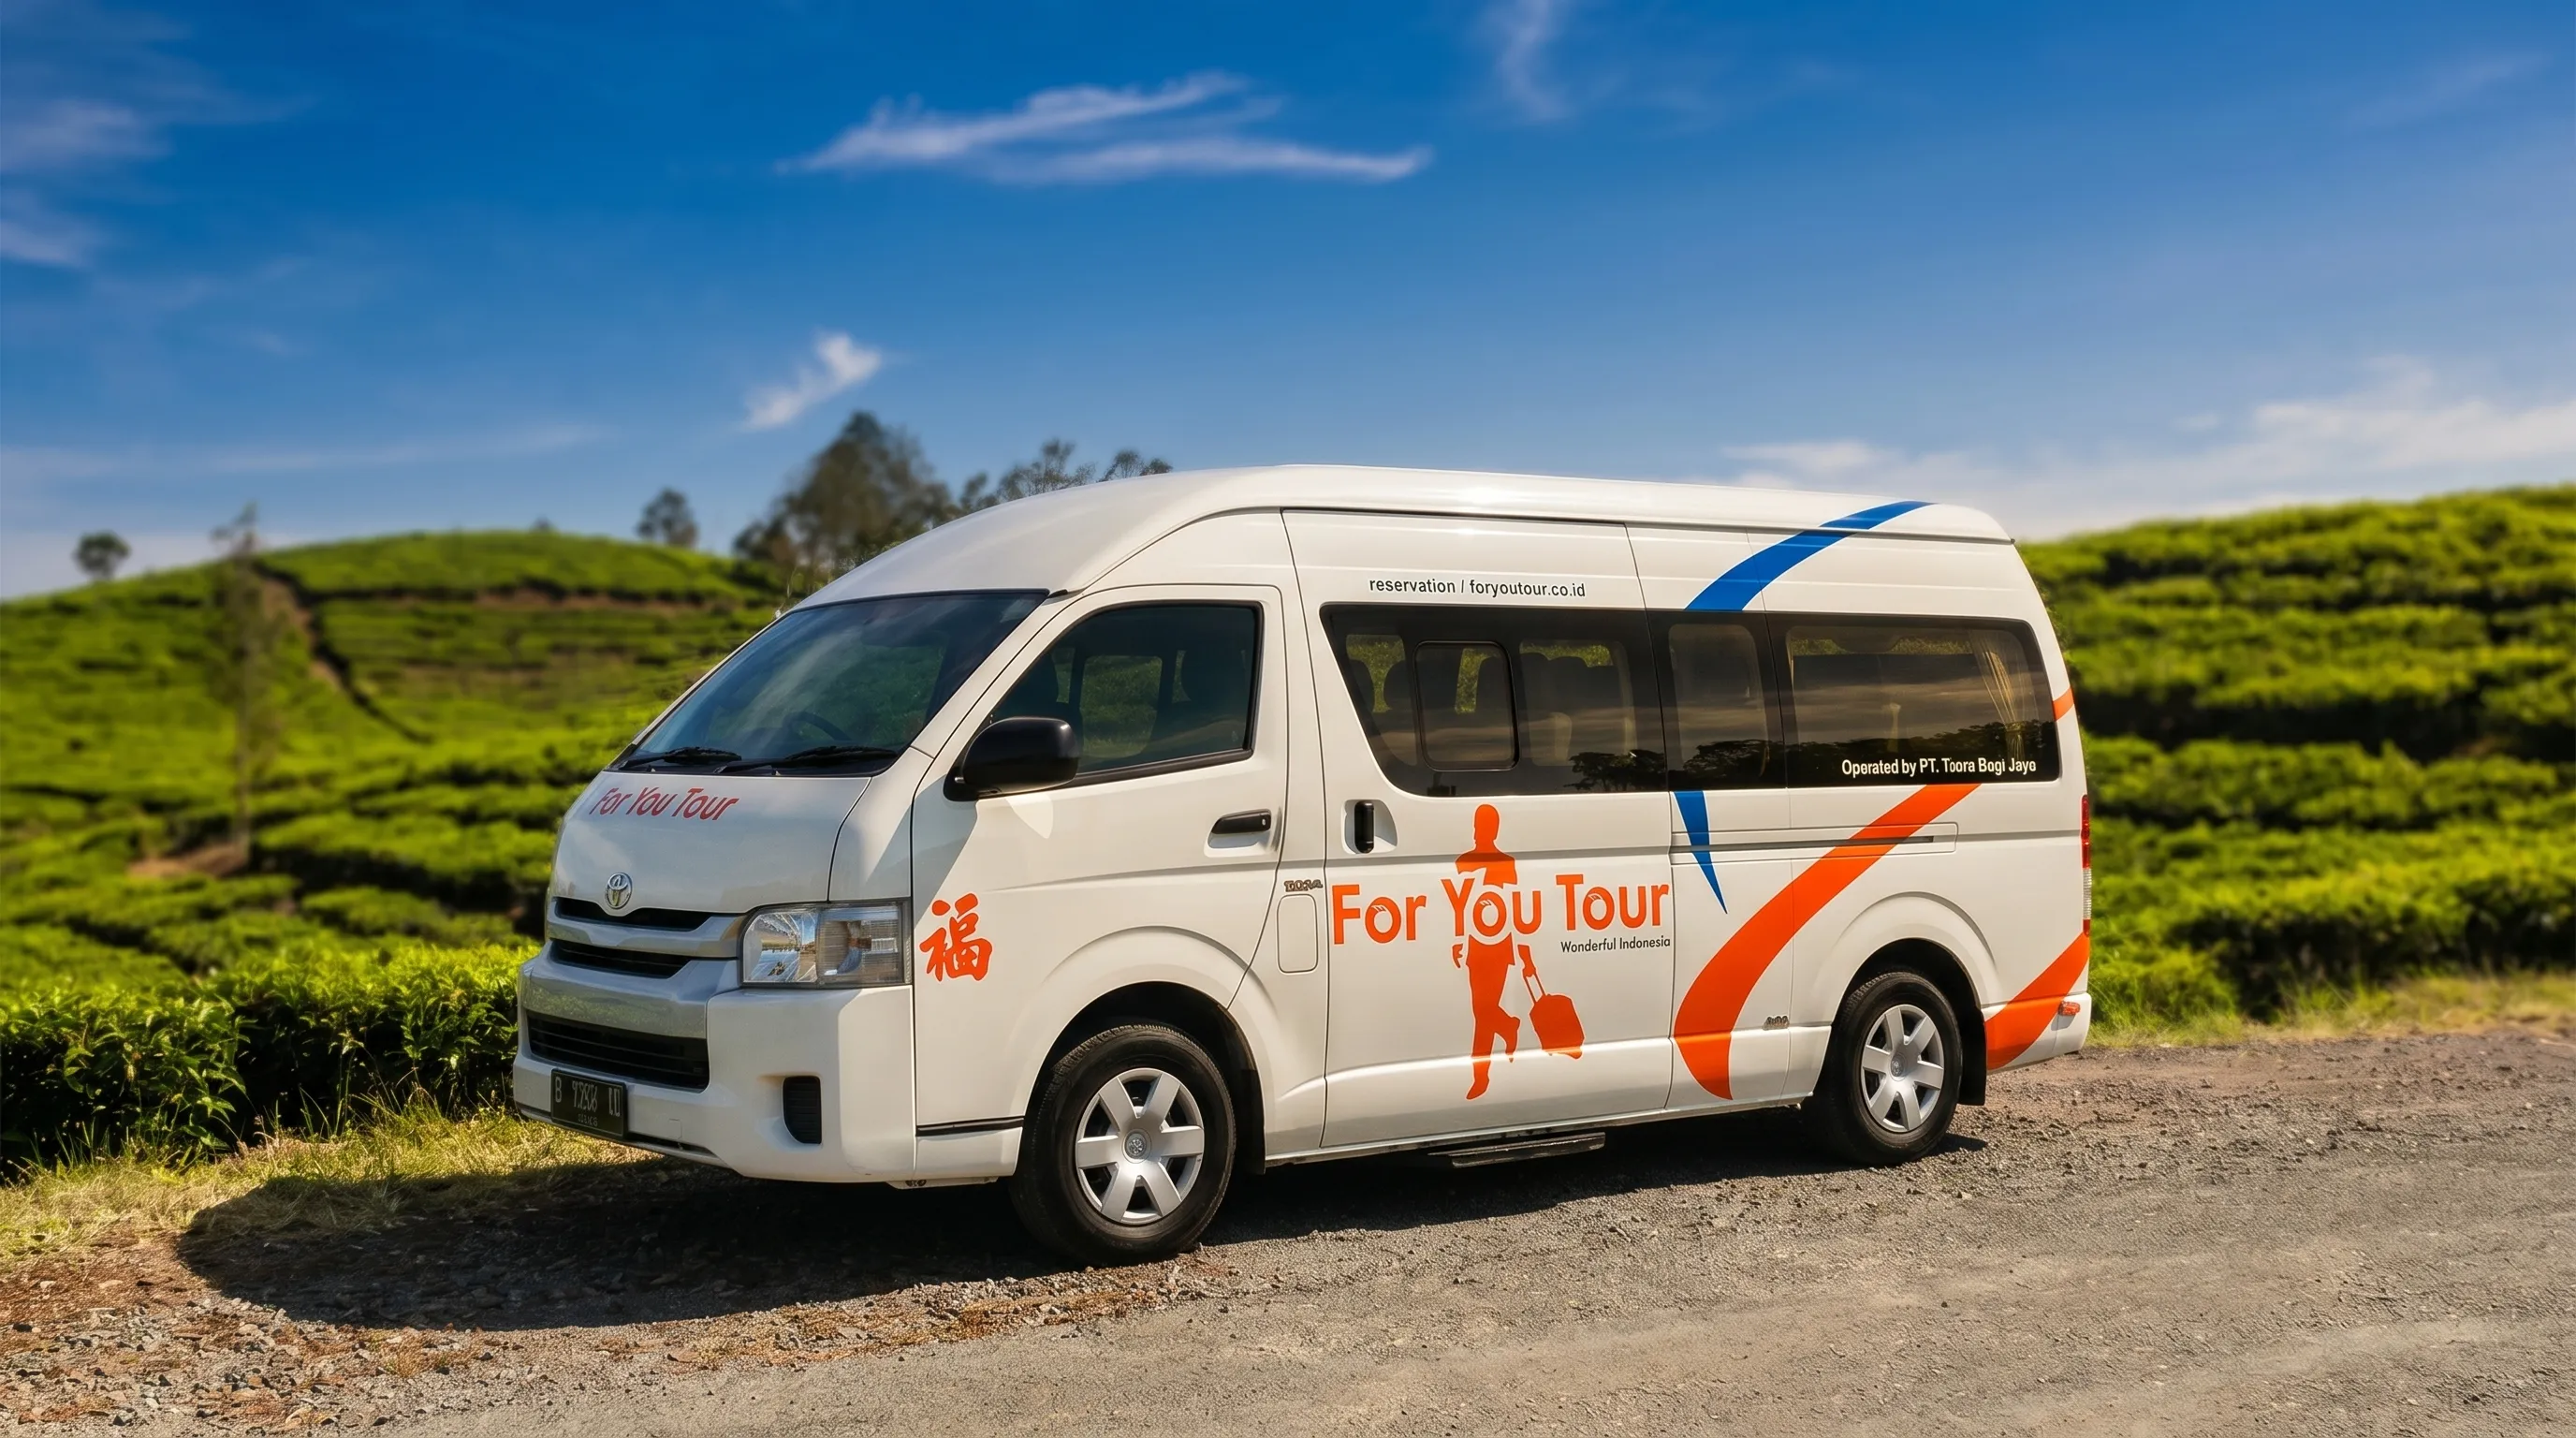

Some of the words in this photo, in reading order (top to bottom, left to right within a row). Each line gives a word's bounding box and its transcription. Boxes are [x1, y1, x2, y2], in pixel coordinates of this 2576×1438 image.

[1369, 578, 1456, 594] reservation
[1460, 580, 1465, 594] /
[1469, 579, 1586, 598] foryoutour.co.id
[1841, 758, 1899, 779] Operated
[1901, 758, 1917, 778] by
[1919, 757, 1939, 773] PT.
[1940, 757, 1976, 773] Toora
[589, 787, 633, 815] For
[625, 786, 678, 816] You
[671, 787, 739, 821] Tour
[1331, 884, 1427, 946] For
[1441, 877, 1543, 938] You
[1555, 873, 1670, 932] Tour
[919, 892, 993, 982] 福
[1559, 937, 1617, 953] Wonderful
[1619, 934, 1671, 950] Indonesia
